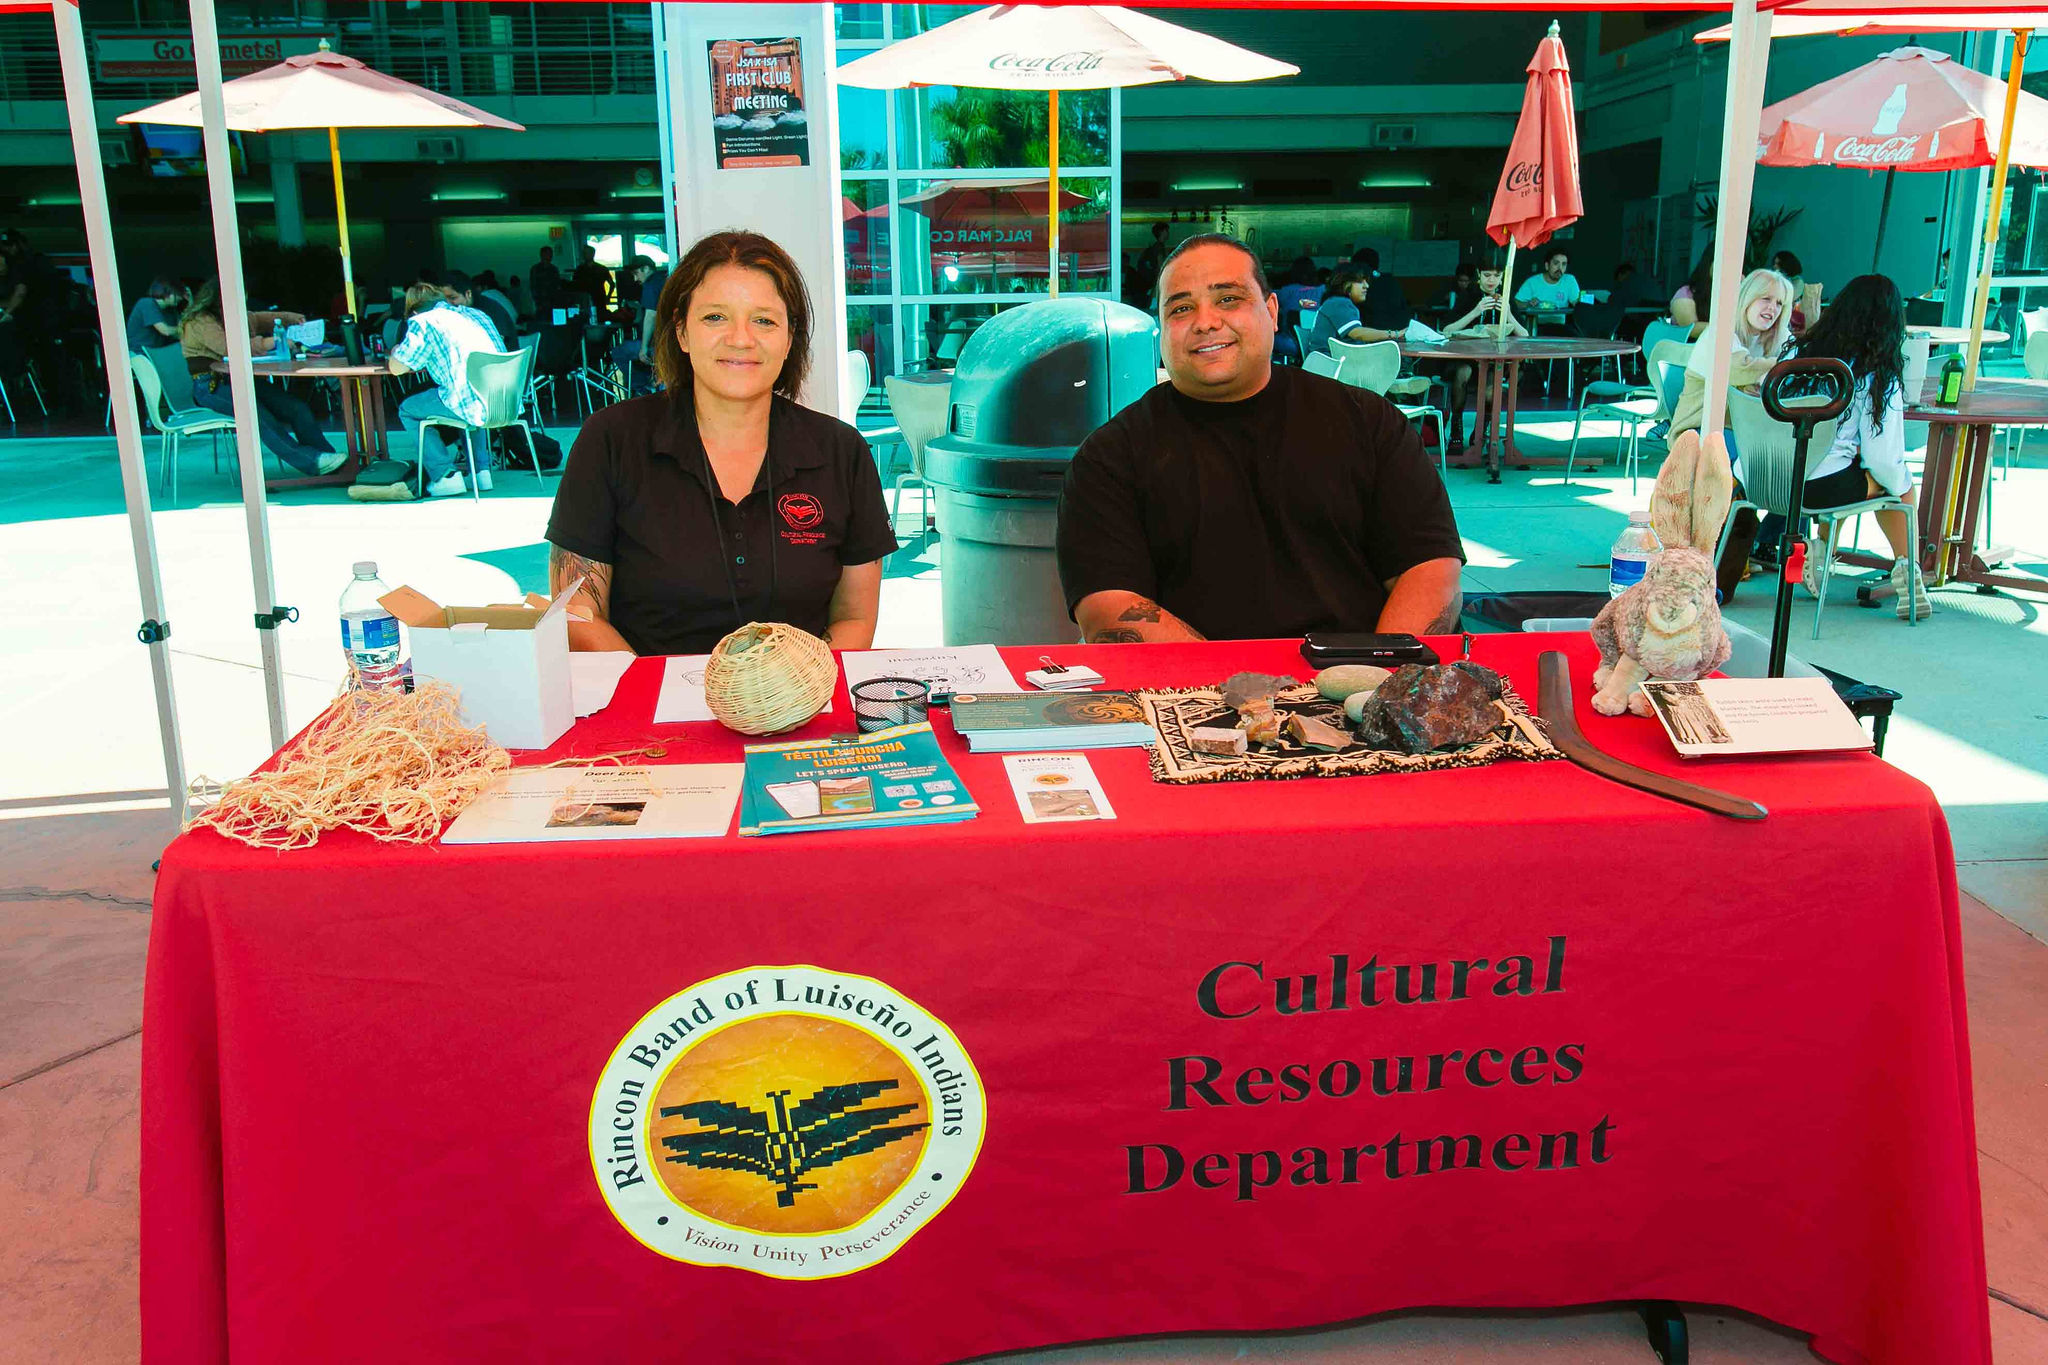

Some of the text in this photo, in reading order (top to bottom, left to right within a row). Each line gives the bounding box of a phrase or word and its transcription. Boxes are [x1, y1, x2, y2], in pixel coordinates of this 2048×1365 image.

[153, 39, 282, 60] Go mets!
[989, 51, 1104, 72] Coca-Cola
[726, 71, 792, 87] FIRST CLUB
[734, 94, 788, 110] MEETING
[1834, 134, 1921, 163] Coca-Cola
[796, 769, 825, 778] LET'S
[826, 767, 860, 776] SPEAK
[1196, 935, 1567, 1020] Cultural
[607, 978, 964, 1193] Rincon Band of Luiseño Indians
[1161, 1040, 1585, 1112] Resources
[1120, 1113, 1618, 1203] Department
[682, 1190, 932, 1266] Vision Unity Perseverance
